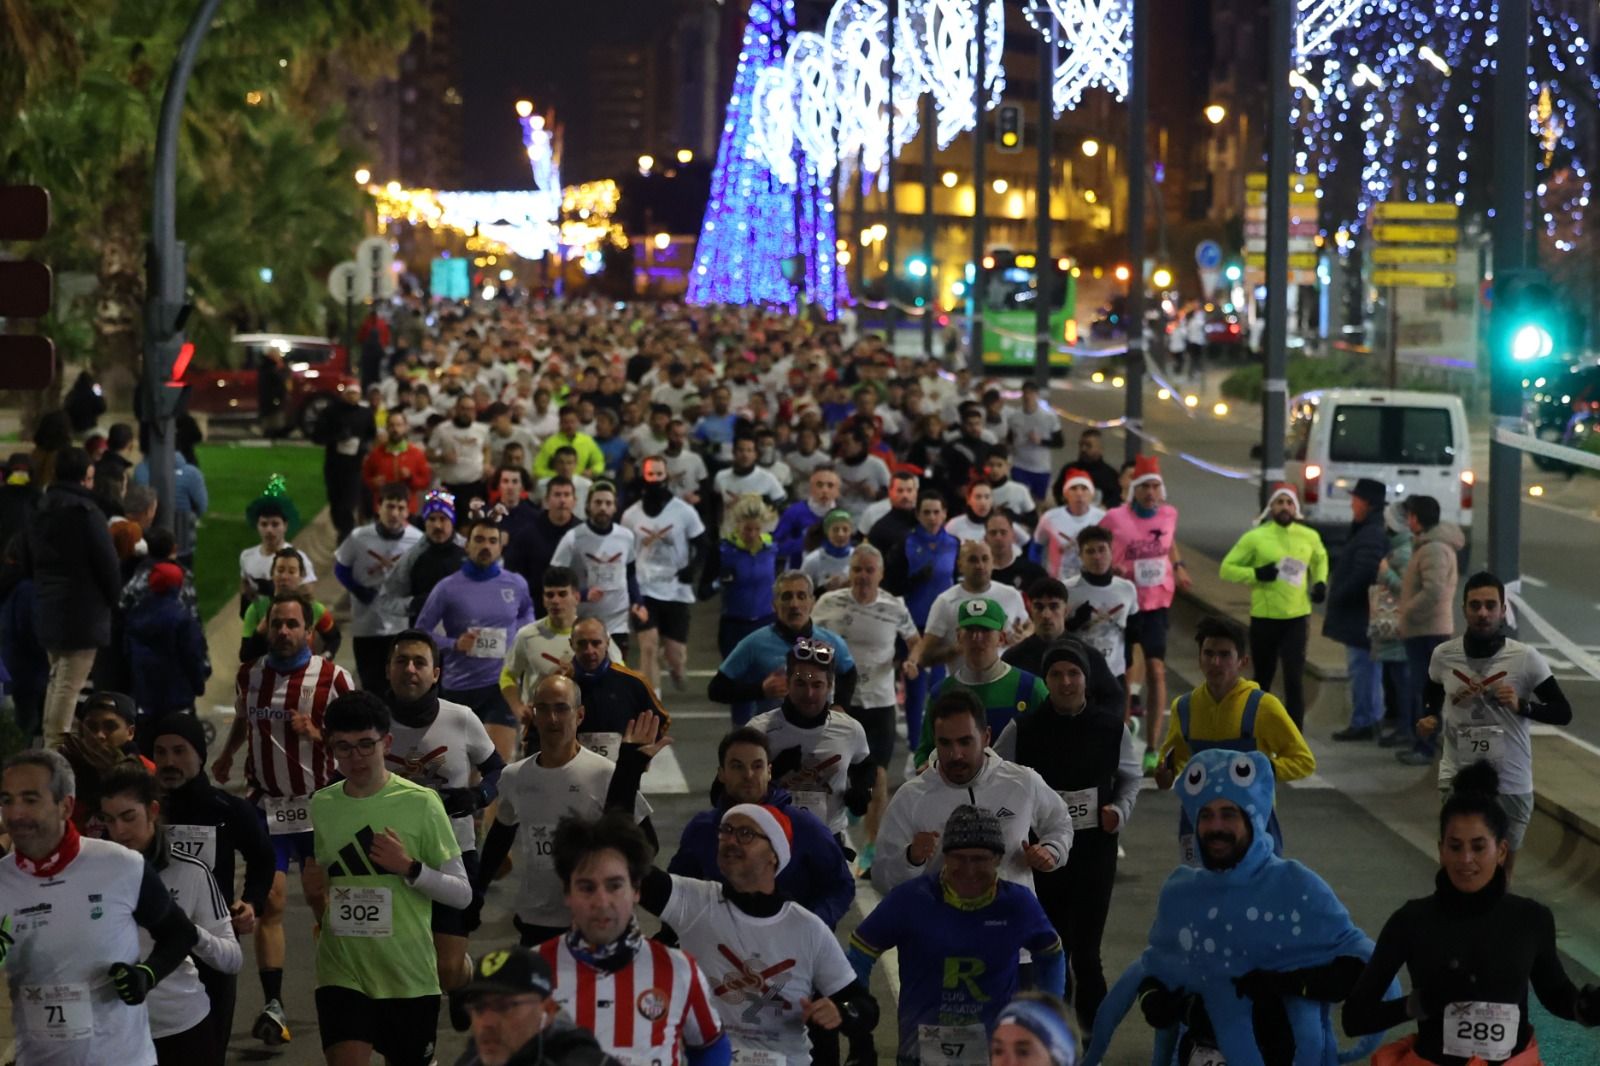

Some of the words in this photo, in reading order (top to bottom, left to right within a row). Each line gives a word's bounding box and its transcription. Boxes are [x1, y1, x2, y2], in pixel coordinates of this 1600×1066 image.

[477, 639, 497, 649] 512
[1471, 740, 1490, 753] 79
[276, 808, 308, 822] 698
[340, 904, 379, 921] 302
[44, 1005, 66, 1023] 71
[1457, 1021, 1505, 1042] 289
[941, 1043, 965, 1056] 57
